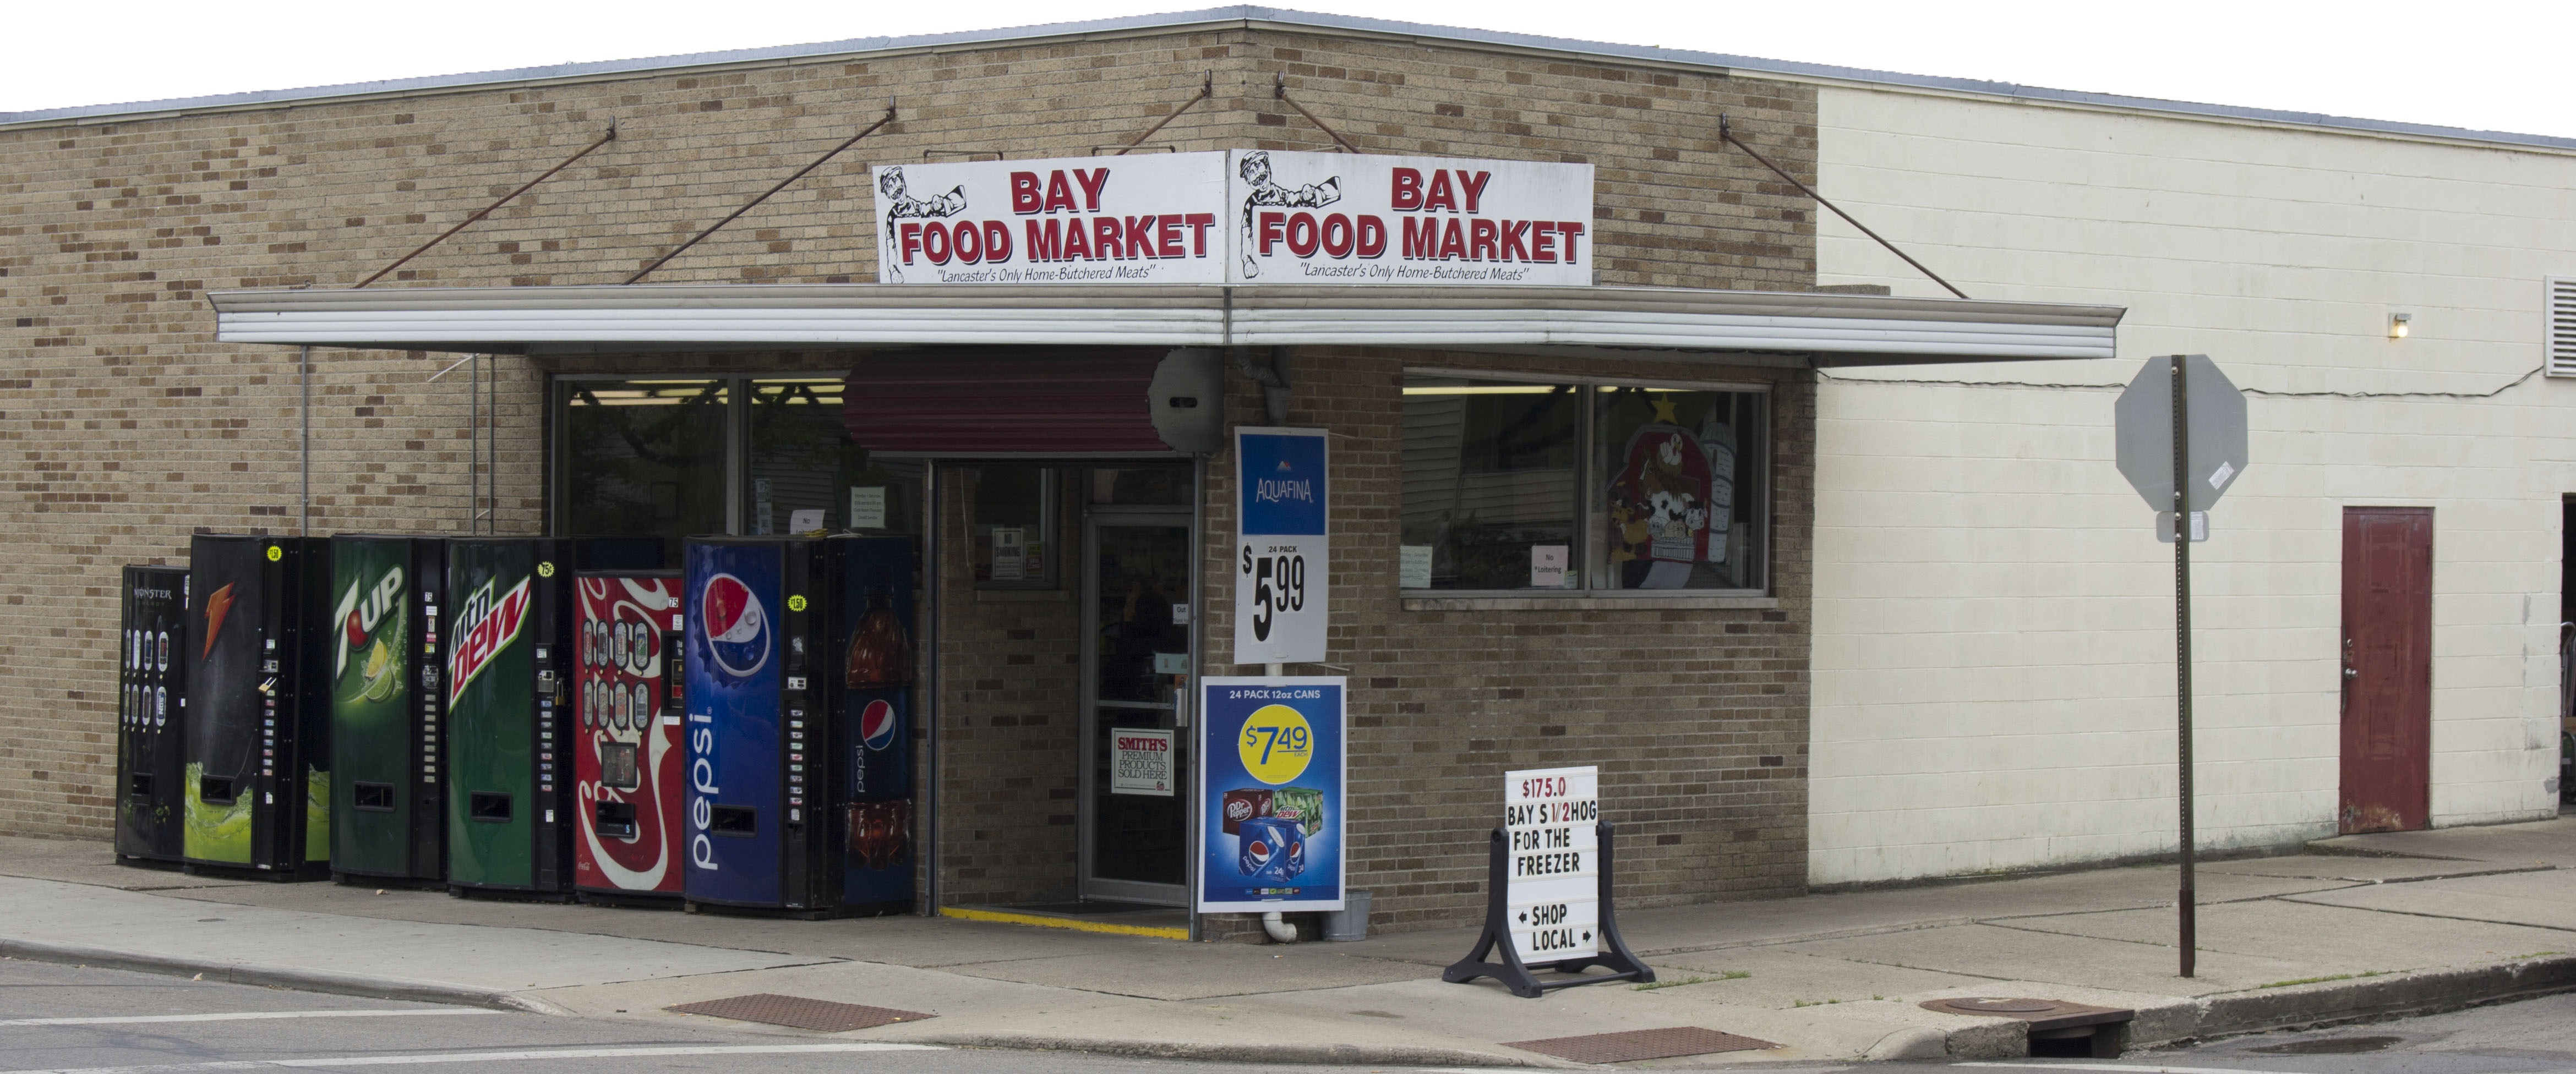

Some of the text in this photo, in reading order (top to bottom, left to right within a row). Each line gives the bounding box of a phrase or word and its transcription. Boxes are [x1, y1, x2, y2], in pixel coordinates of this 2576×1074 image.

[1010, 167, 1110, 215] BAY
[1391, 167, 1490, 213] BAY
[900, 213, 1215, 265] FOOD MARKET
[1259, 211, 1584, 264] FOOD MARKET
[937, 265, 1156, 284] "Lancaster's Only Home-Butchered Meats"
[1300, 262, 1529, 283] "Lancaster's Only Home-Butchered Meats"
[1256, 478, 1312, 503] AQUAFINA
[1005, 533, 1012, 543] NO
[996, 546, 1021, 557] SMOKING
[134, 587, 172, 600] MONSTER
[425, 592, 432, 602] 75
[669, 598, 678, 607] 75
[1230, 689, 1320, 699] 24 PACK 12oz CANS
[1118, 737, 1167, 752] SMITH'S
[1120, 760, 1166, 770] PRODUCTS
[1122, 750, 1163, 761] PREMIUM
[856, 745, 866, 793] pepsi
[1118, 769, 1167, 780] SOLD HERE
[689, 714, 719, 870] pepsi
[1230, 803, 1251, 818] Pepper
[1236, 801, 1245, 810] Dr
[1508, 805, 1534, 826] BAY
[1540, 803, 1547, 824] S
[1514, 828, 1570, 851] FOR THE
[1243, 856, 1256, 872] pepsi
[1518, 852, 1580, 876] FREEZER
[1532, 904, 1567, 926] SHOP
[1533, 928, 1576, 951] LOCAL
